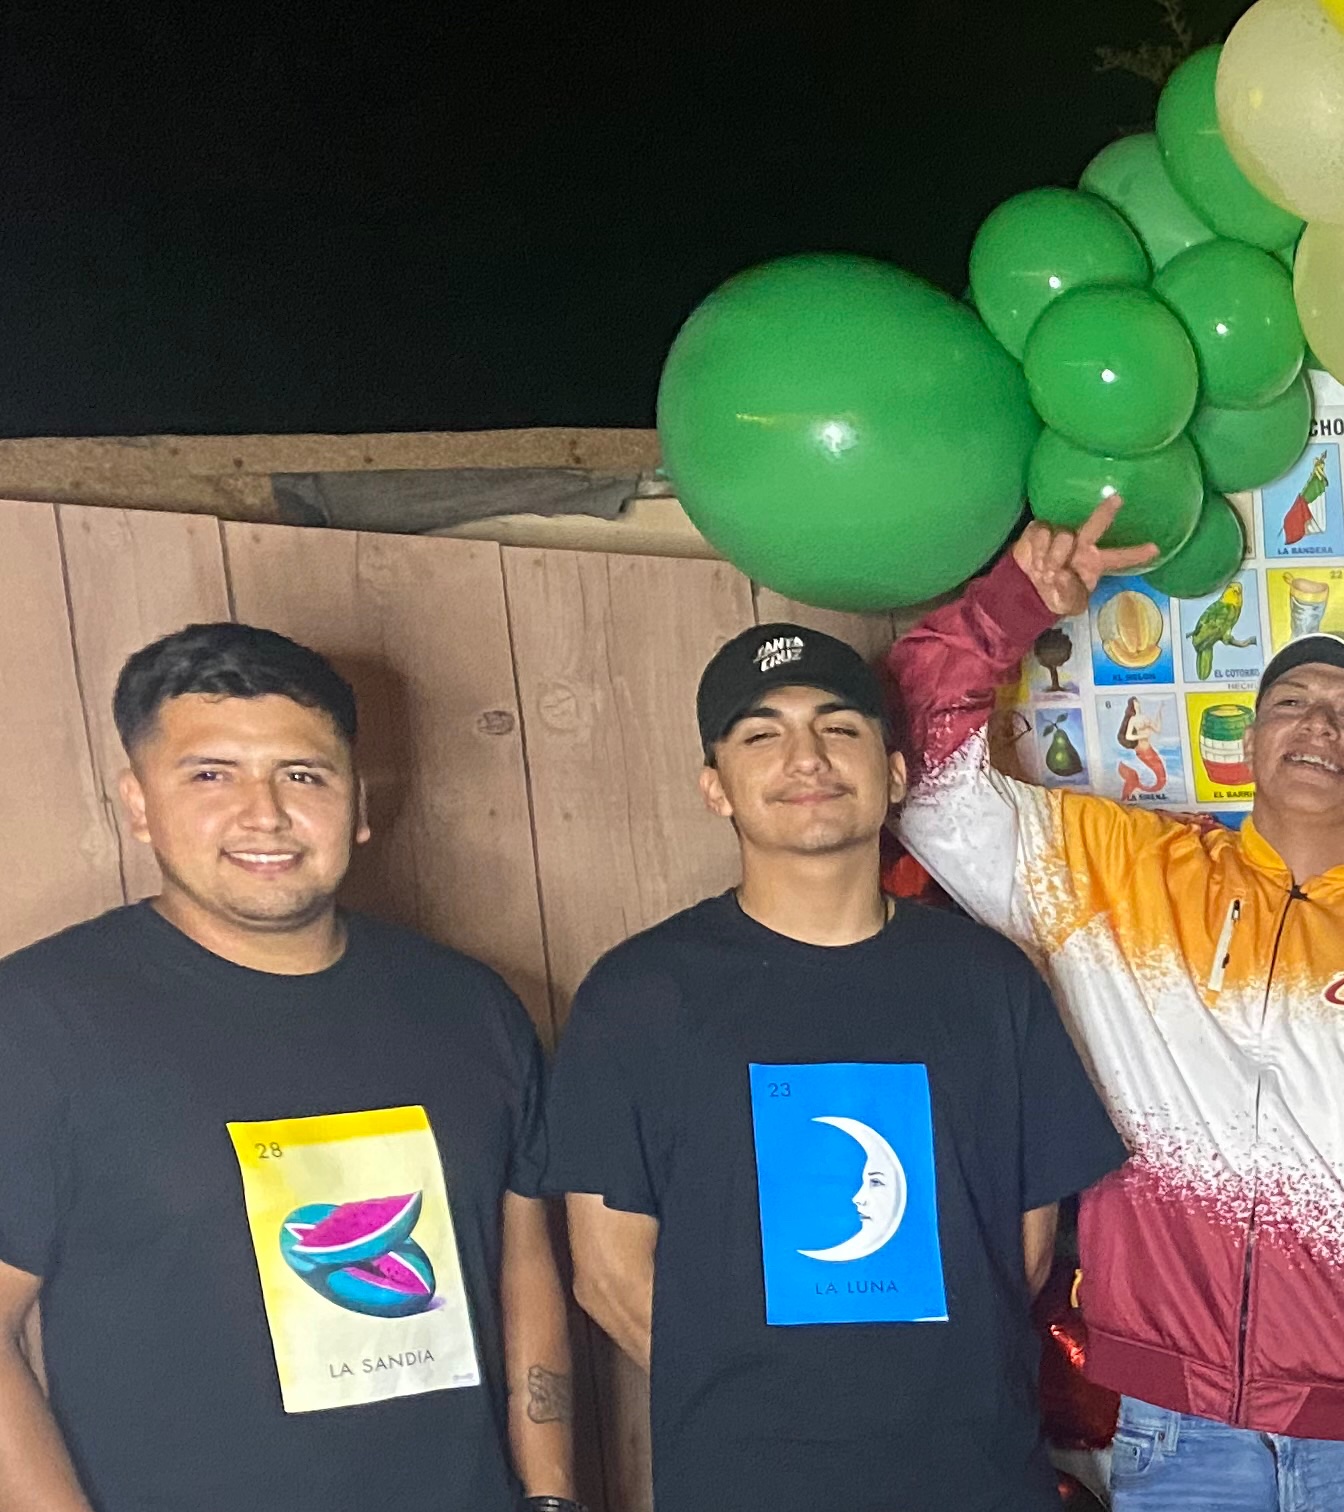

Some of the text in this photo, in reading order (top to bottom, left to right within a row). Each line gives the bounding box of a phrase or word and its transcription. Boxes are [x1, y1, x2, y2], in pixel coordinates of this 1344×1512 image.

[1278, 547, 1288, 555] LA
[1330, 570, 1343, 579] 22
[760, 648, 804, 672] CRUZ
[1214, 670, 1224, 678] EL
[767, 1082, 792, 1097] 23
[254, 1142, 283, 1159] 28
[815, 1280, 899, 1295] LA LUNA
[329, 1350, 435, 1379] LA SANDIA
